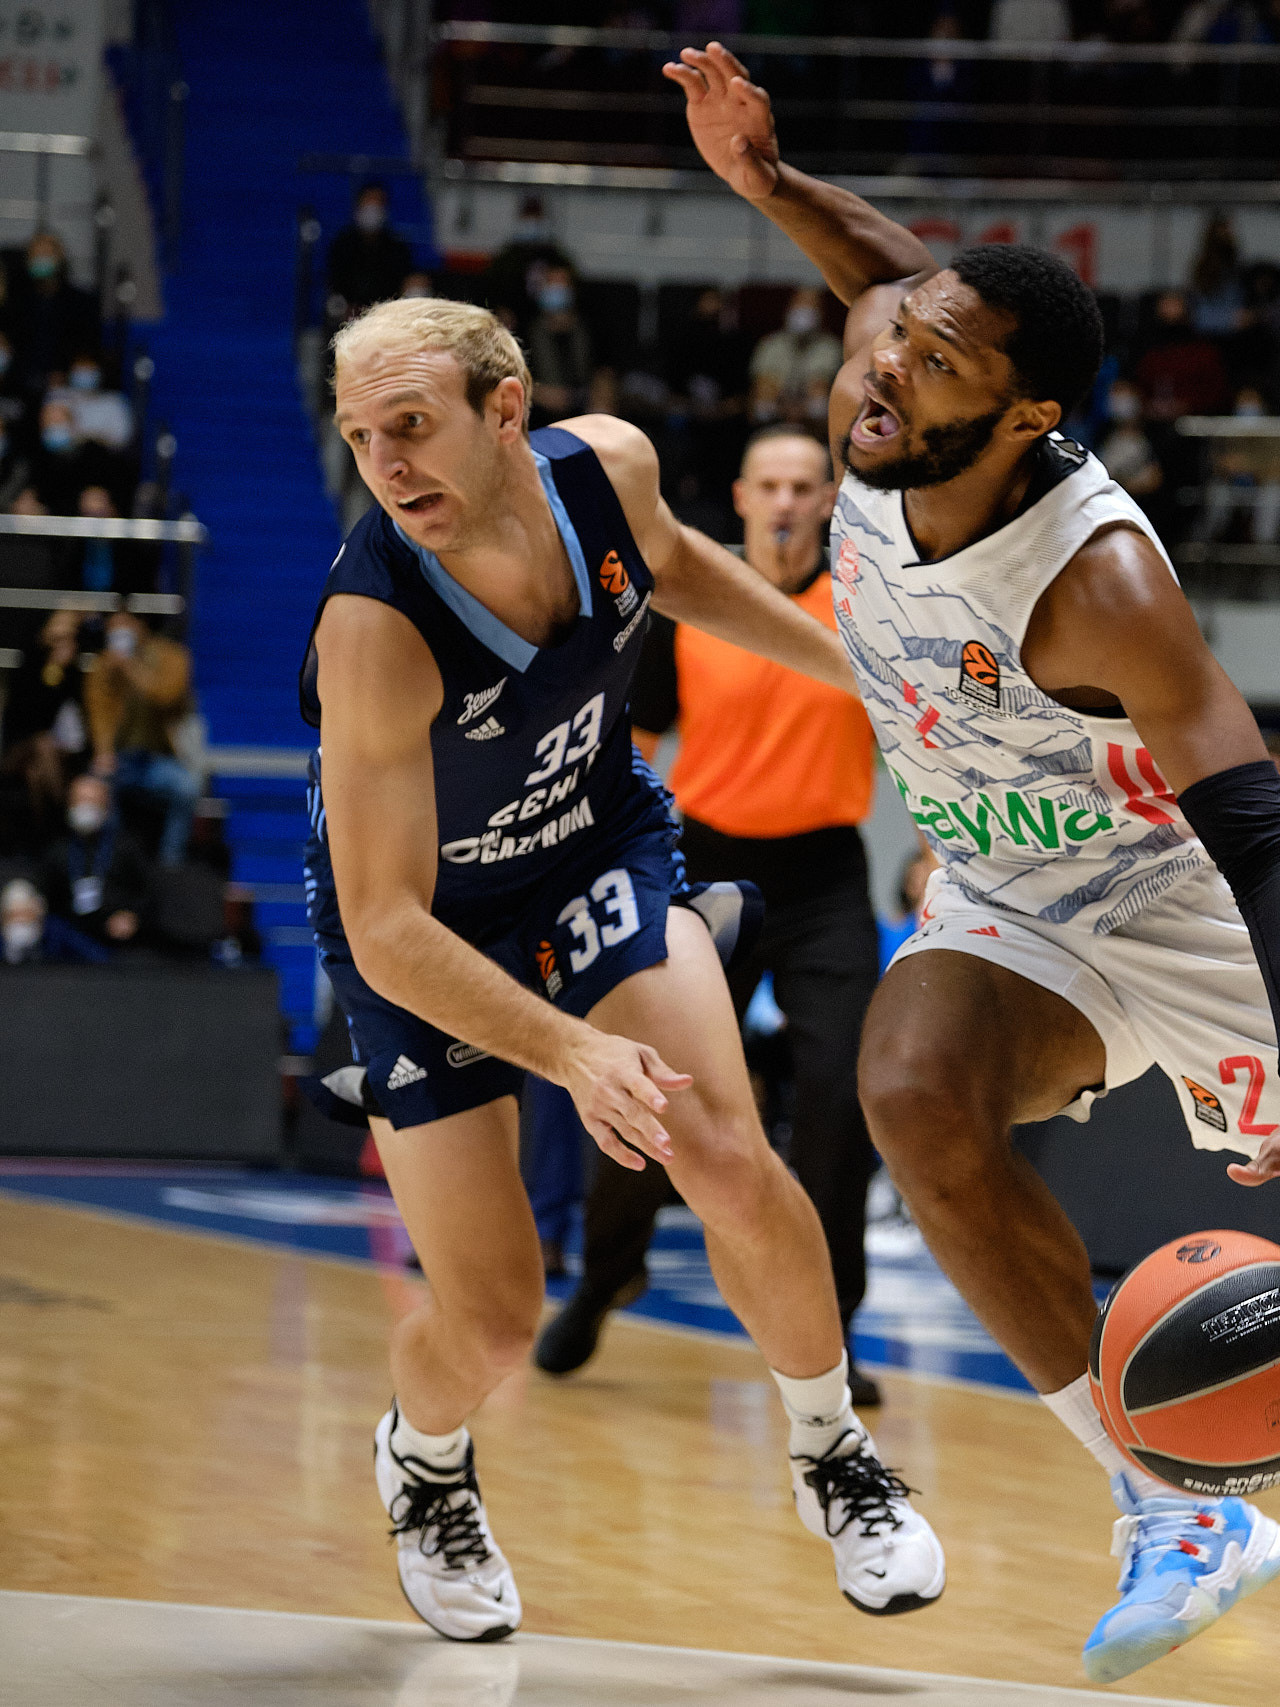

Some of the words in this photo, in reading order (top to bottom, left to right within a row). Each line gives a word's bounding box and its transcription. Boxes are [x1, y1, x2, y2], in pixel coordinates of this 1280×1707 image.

[465, 725, 505, 741] adidas
[524, 691, 605, 786] 33
[889, 766, 1115, 857] ayWa
[556, 868, 640, 973] 33
[386, 1066, 428, 1091] adidas
